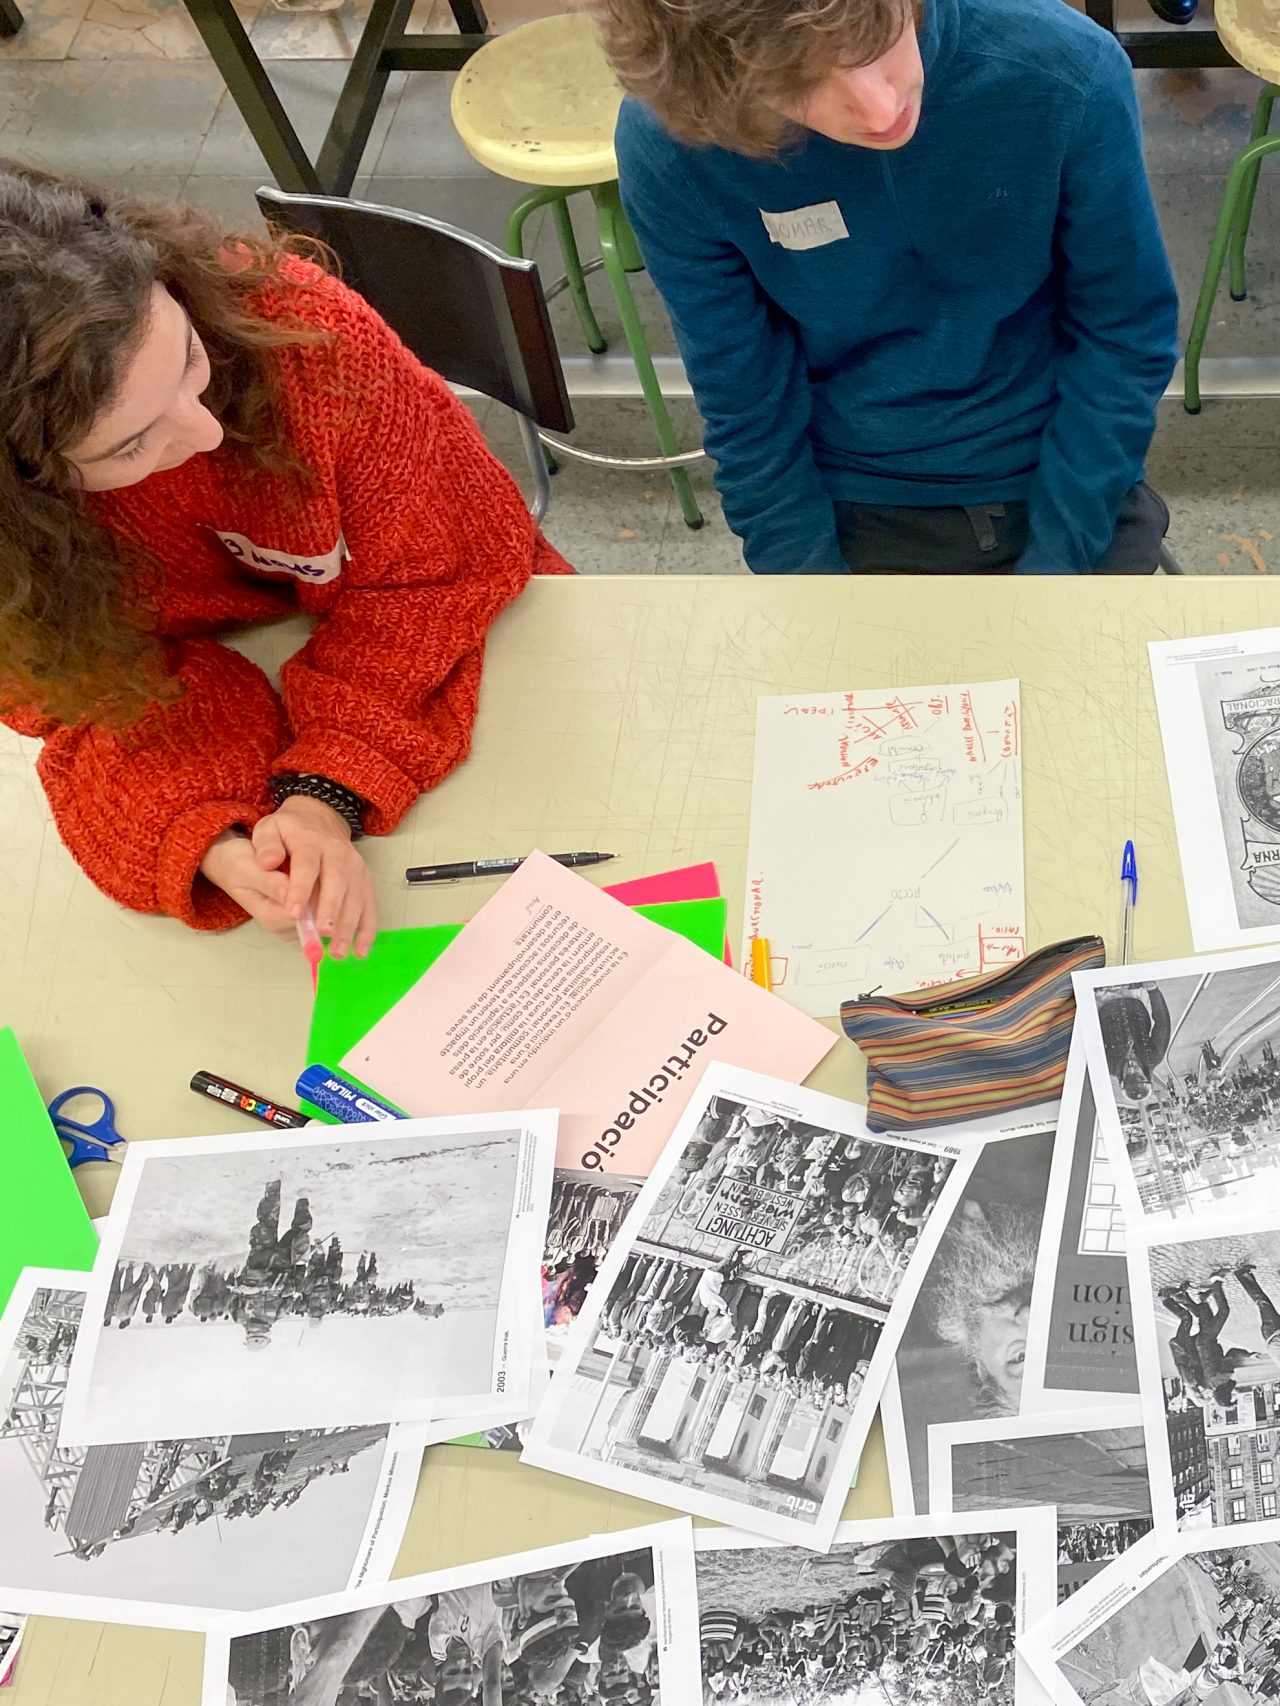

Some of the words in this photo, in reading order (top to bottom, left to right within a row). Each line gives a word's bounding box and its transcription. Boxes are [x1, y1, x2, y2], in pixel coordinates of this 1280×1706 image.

[1224, 695, 1280, 713] RACIONAL
[513, 903, 553, 946] comunitats
[538, 915, 570, 949] recursos
[534, 929, 570, 967] decisions
[564, 935, 603, 977] compromís
[570, 930, 596, 958] entorn
[484, 926, 546, 992] desenvolupament
[510, 949, 539, 980] accions
[560, 940, 612, 996] responsabilitat
[588, 944, 620, 979] activitat
[496, 978, 513, 995] que
[505, 964, 538, 999] respecte
[541, 965, 564, 989] cerca
[550, 974, 568, 993] amb
[569, 966, 612, 1013] involucració
[476, 992, 500, 1017] tenen
[530, 986, 545, 1001] del
[463, 1000, 479, 1015] les
[526, 999, 545, 1018] cura
[530, 994, 563, 1029] personal
[443, 1011, 468, 1037] seves
[466, 1014, 480, 1028] un
[438, 1025, 470, 1058] impacte
[450, 1038, 470, 1058] dels
[487, 1032, 502, 1048] per
[493, 1027, 520, 1055] millora
[526, 1028, 556, 1060] individu
[447, 1052, 471, 1077] presa
[466, 1045, 491, 1070] sobre
[481, 1052, 496, 1068] del
[456, 1067, 470, 1081] de
[462, 1065, 484, 1088] propi
[502, 1067, 520, 1086] una
[321, 1076, 358, 1102] MILAN
[579, 1014, 728, 1174] Participació
[943, 1145, 961, 1155] 1989
[704, 1213, 776, 1250] ACHTUNG!
[496, 1370, 506, 1392] 2003
